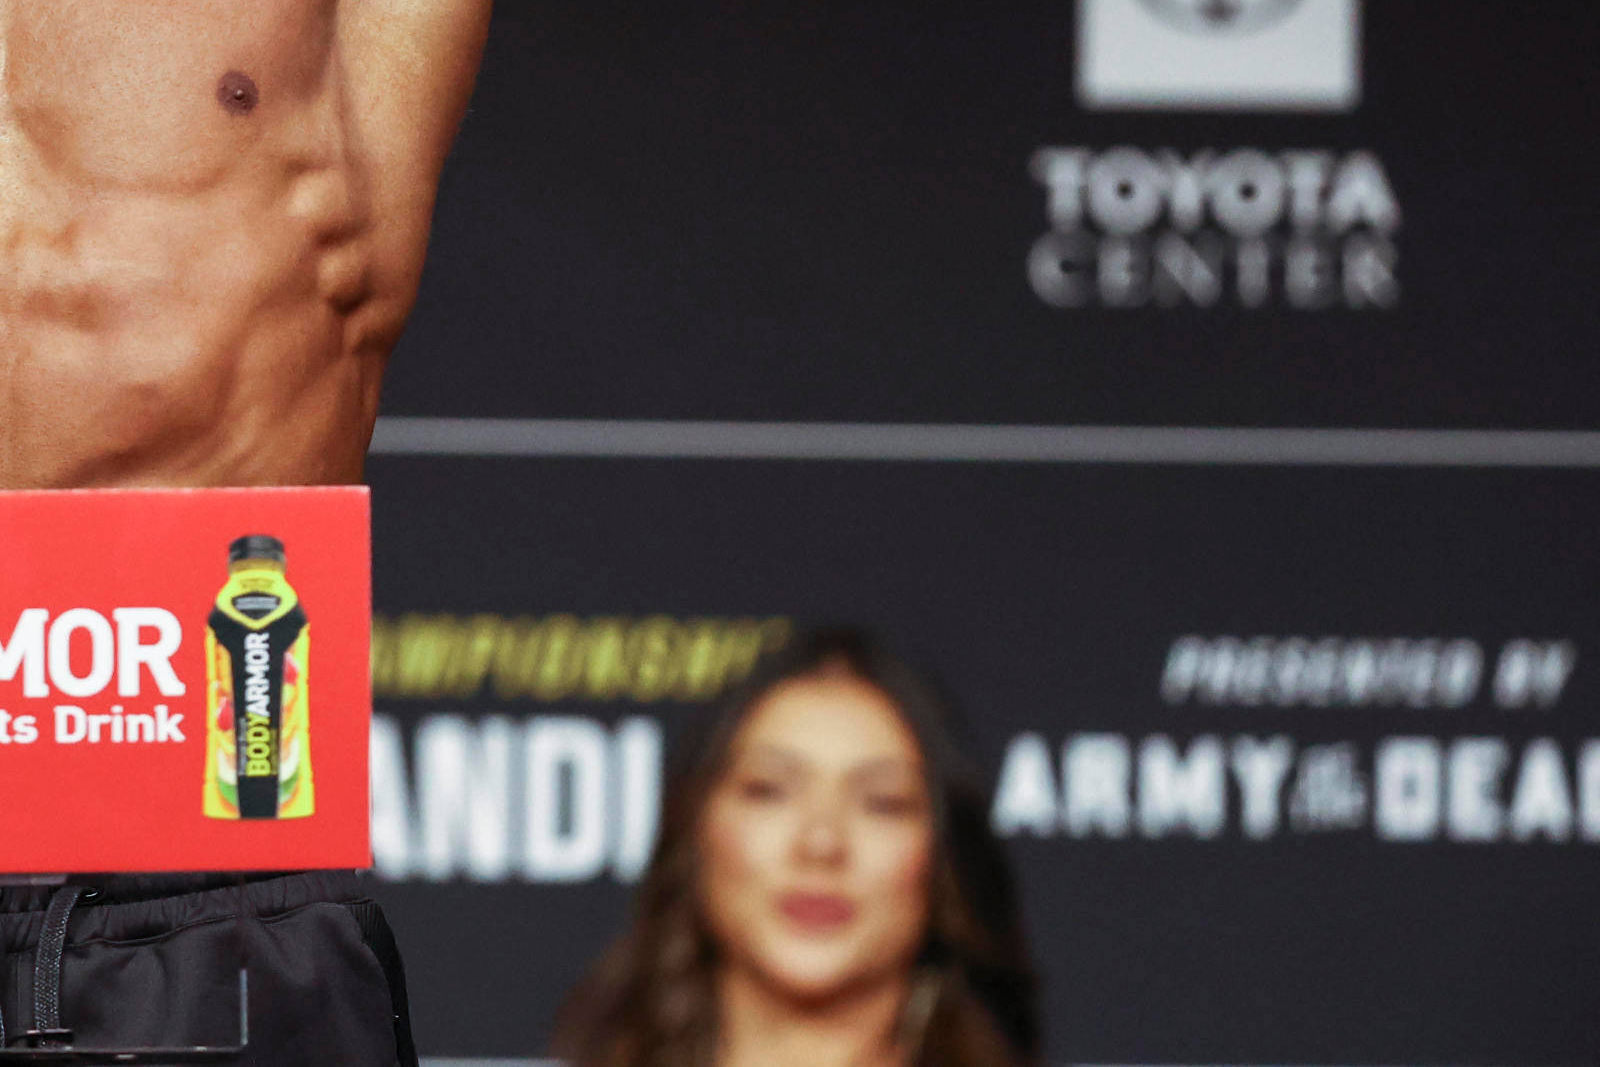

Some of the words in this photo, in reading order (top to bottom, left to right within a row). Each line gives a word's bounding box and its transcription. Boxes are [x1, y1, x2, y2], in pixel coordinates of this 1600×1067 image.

[1030, 145, 1400, 235] TOYOTA
[1025, 234, 1400, 309] CENTER
[245, 632, 271, 776] BODYARMOR
[1160, 635, 1484, 709] PRESENTED
[1492, 637, 1576, 709] BY
[54, 704, 186, 743] Drink
[992, 733, 1291, 839] ARMY
